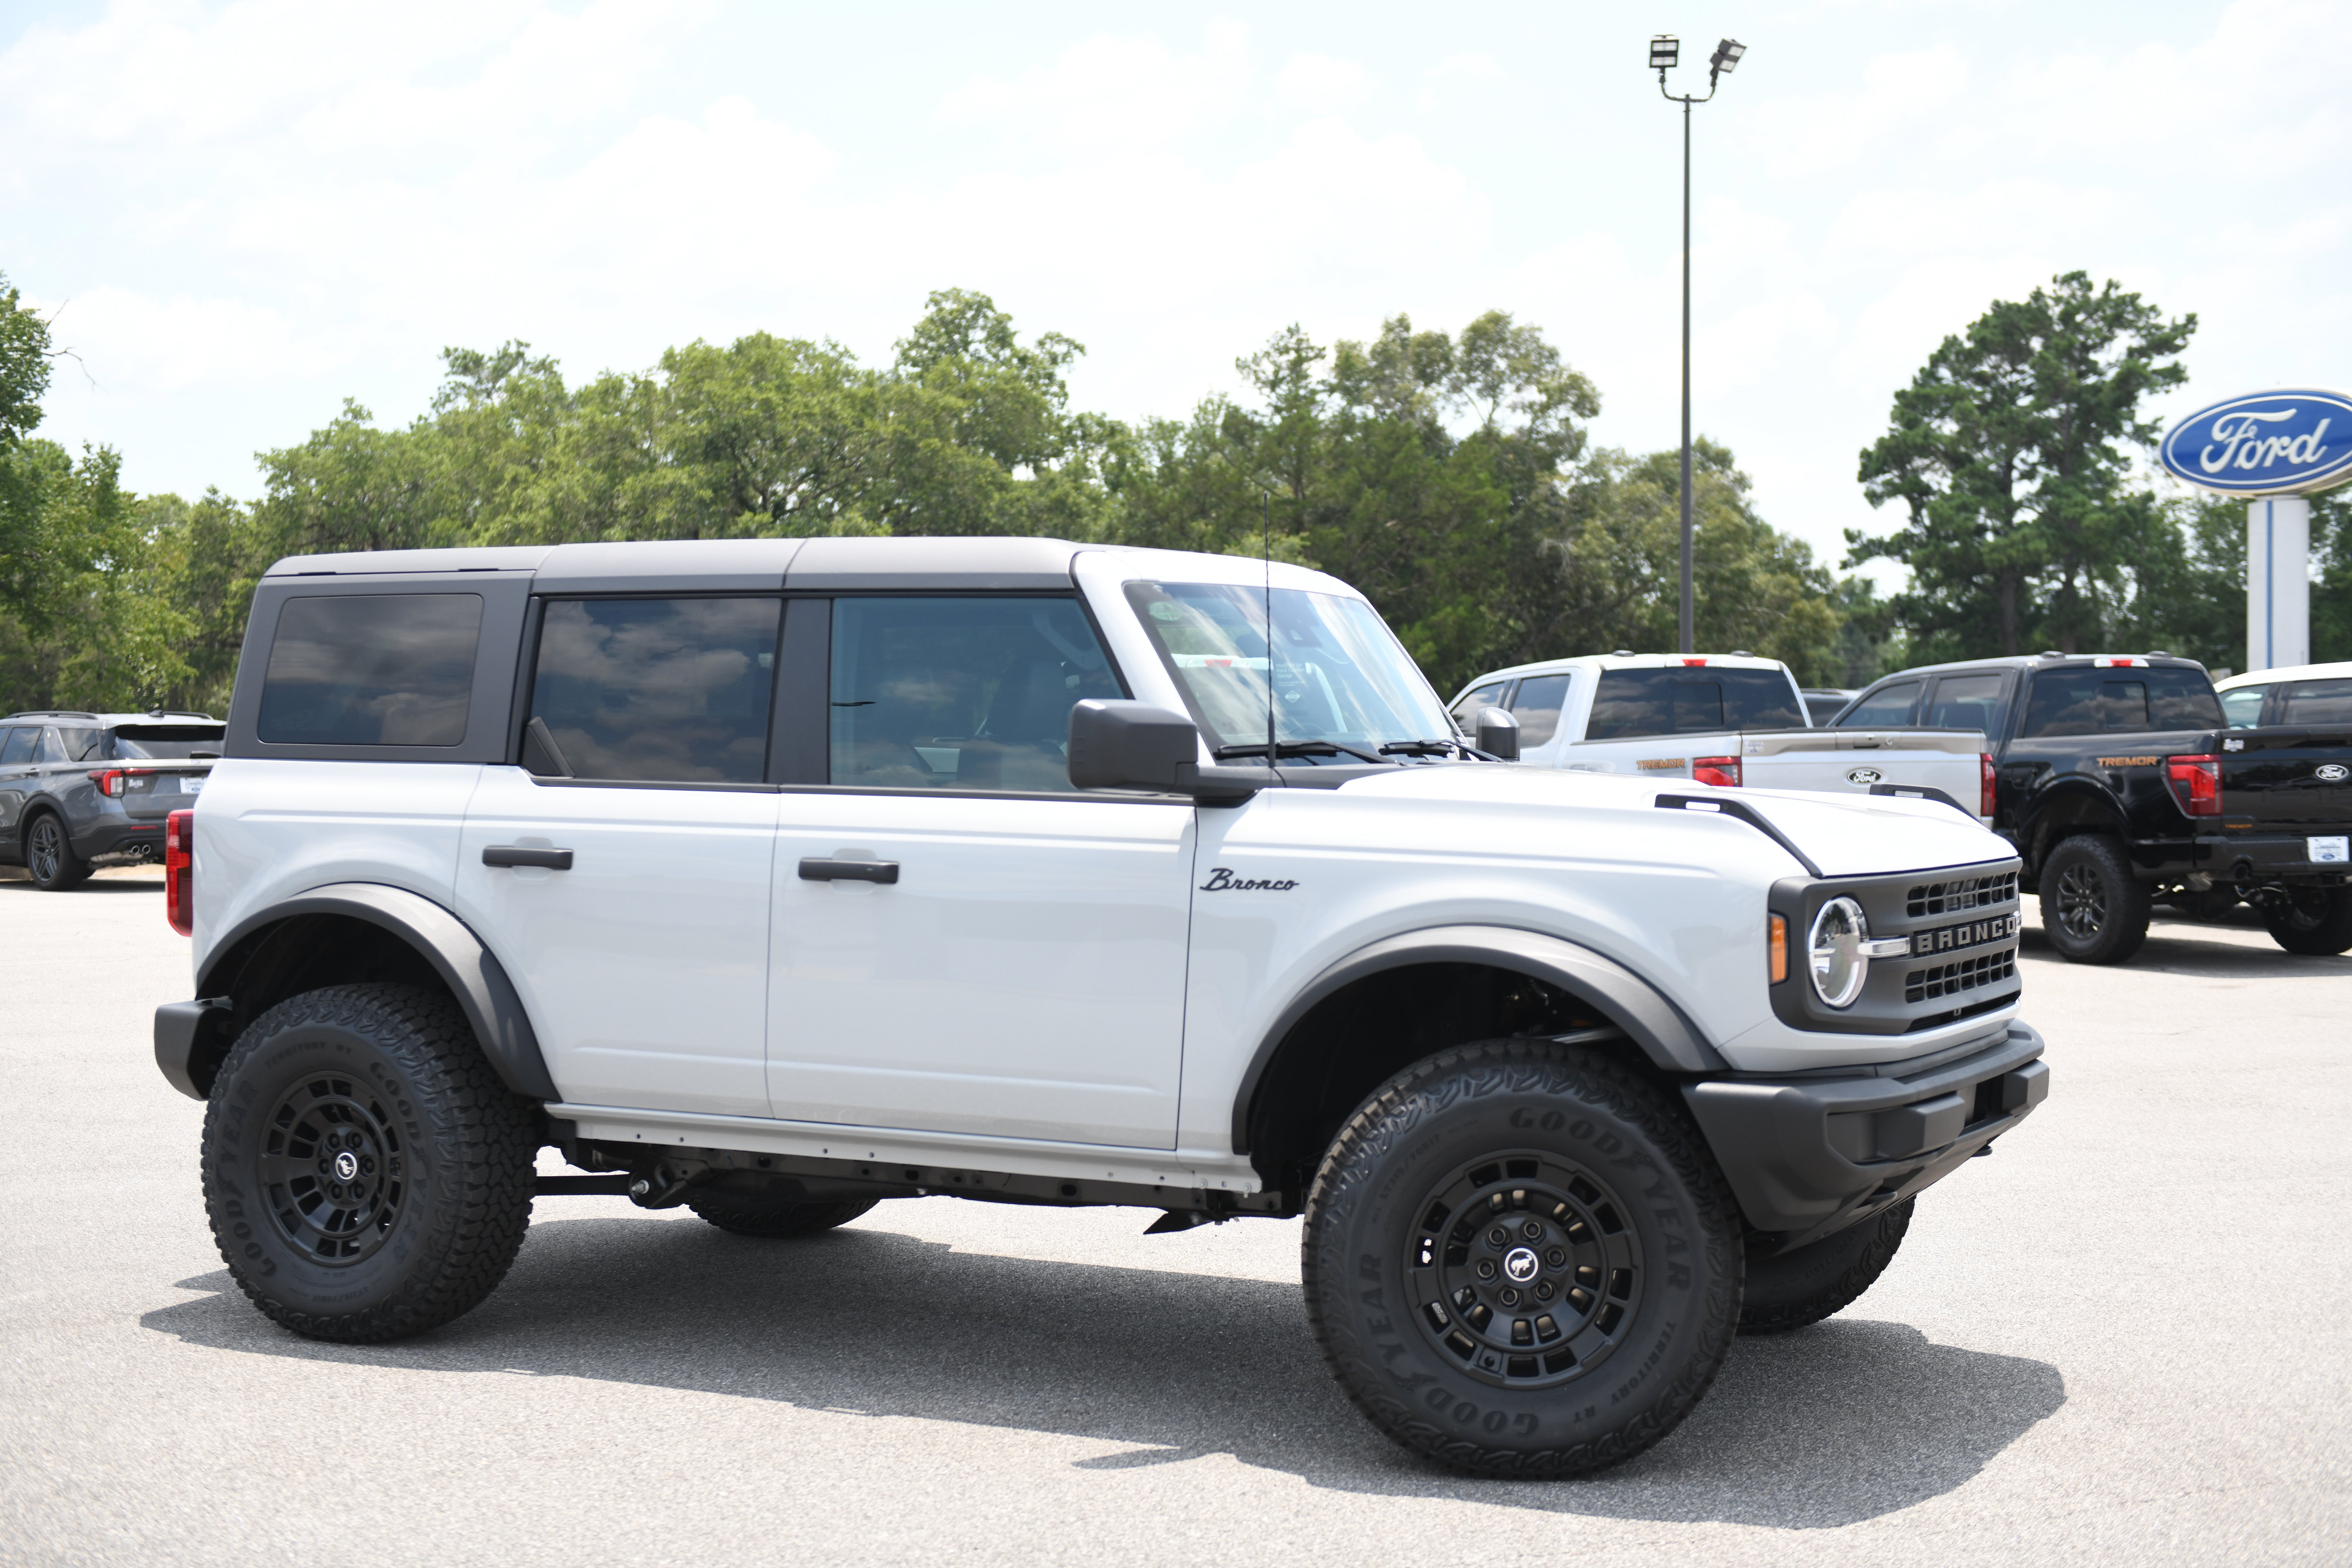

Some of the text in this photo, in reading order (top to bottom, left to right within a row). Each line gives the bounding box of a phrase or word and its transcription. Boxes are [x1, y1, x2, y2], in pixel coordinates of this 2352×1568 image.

[2200, 408, 2332, 474] Ford
[1637, 758, 1686, 770] TREMOR
[1854, 770, 1876, 782] Ford
[2097, 756, 2158, 766] TREMOR
[2321, 766, 2343, 777] Ford
[1199, 868, 1300, 891] Bronco
[1917, 916, 2017, 953] BRONCO
[217, 1080, 276, 1277] GOODYEAR
[370, 1062, 430, 1265] GOODYEAR
[1509, 1107, 1692, 1291] GOODYEAR
[1359, 1254, 1539, 1438] GOODYEAR
[1573, 1321, 1677, 1423] TERRITORY RT
